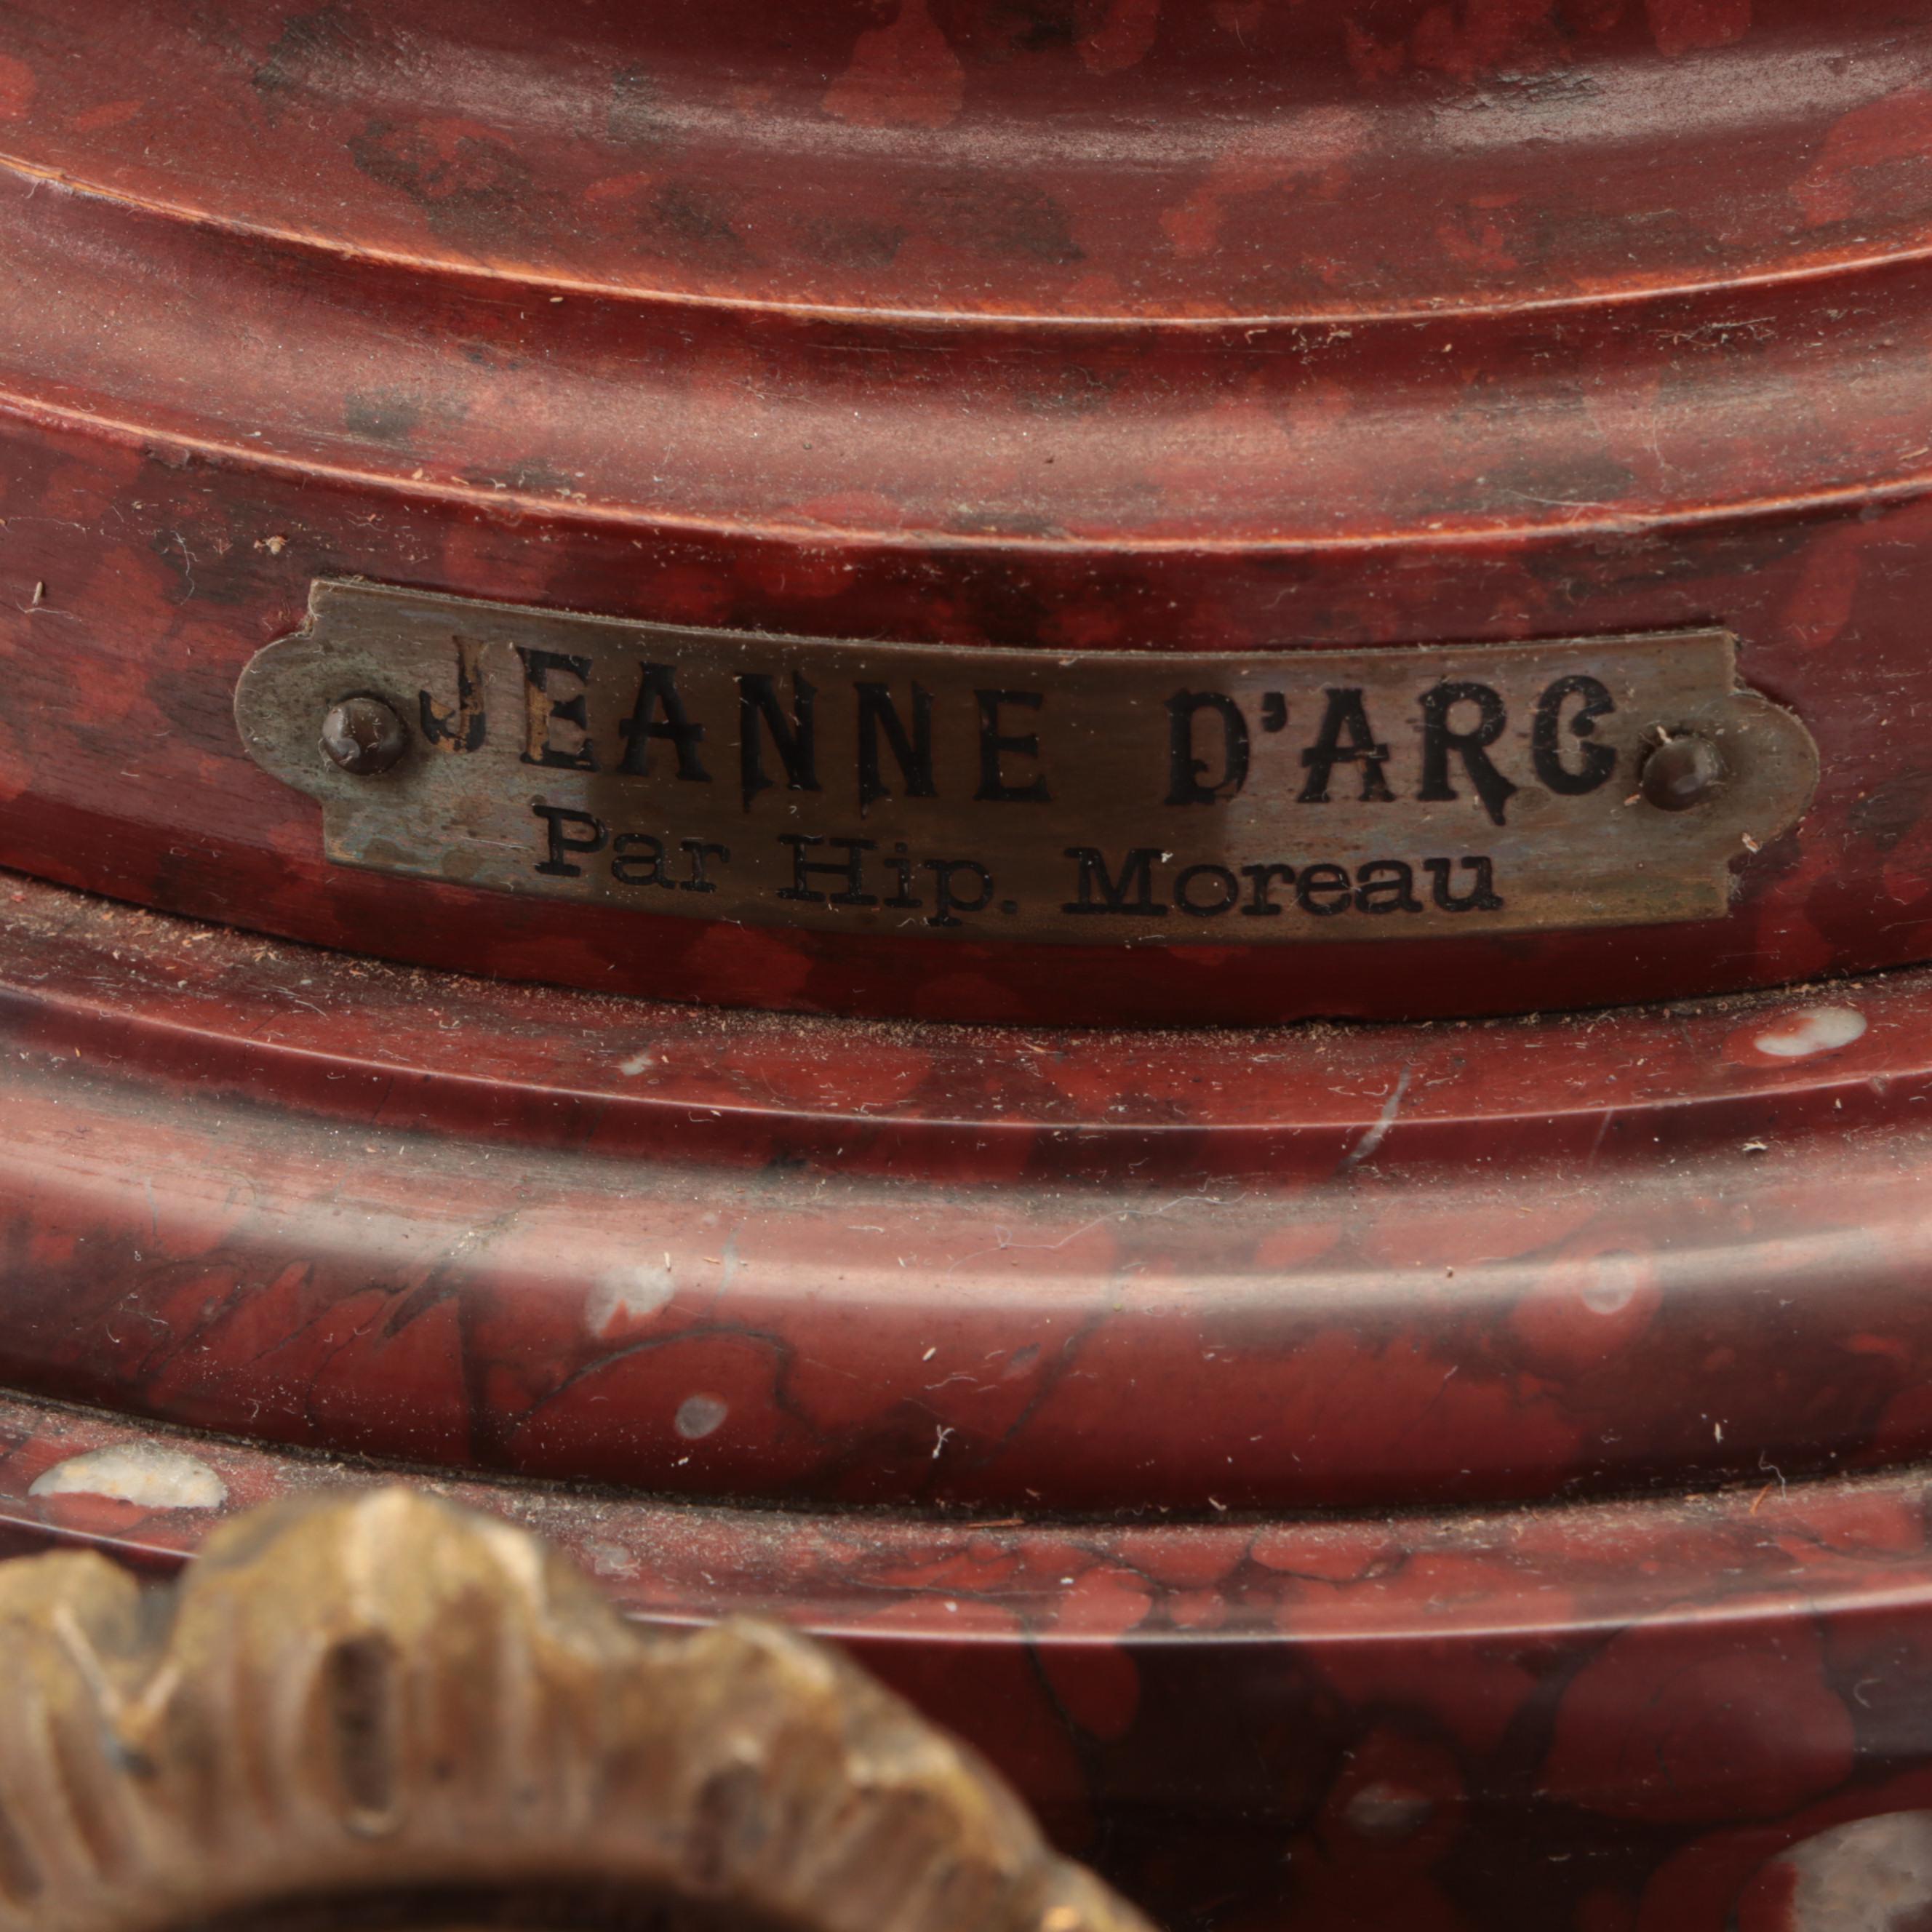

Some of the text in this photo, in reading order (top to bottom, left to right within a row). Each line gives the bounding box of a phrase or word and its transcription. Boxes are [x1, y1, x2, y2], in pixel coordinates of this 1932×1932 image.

[419, 636, 1616, 826] JEANNE D'ARC
[532, 805, 1504, 927] Par Hip. Moreau
